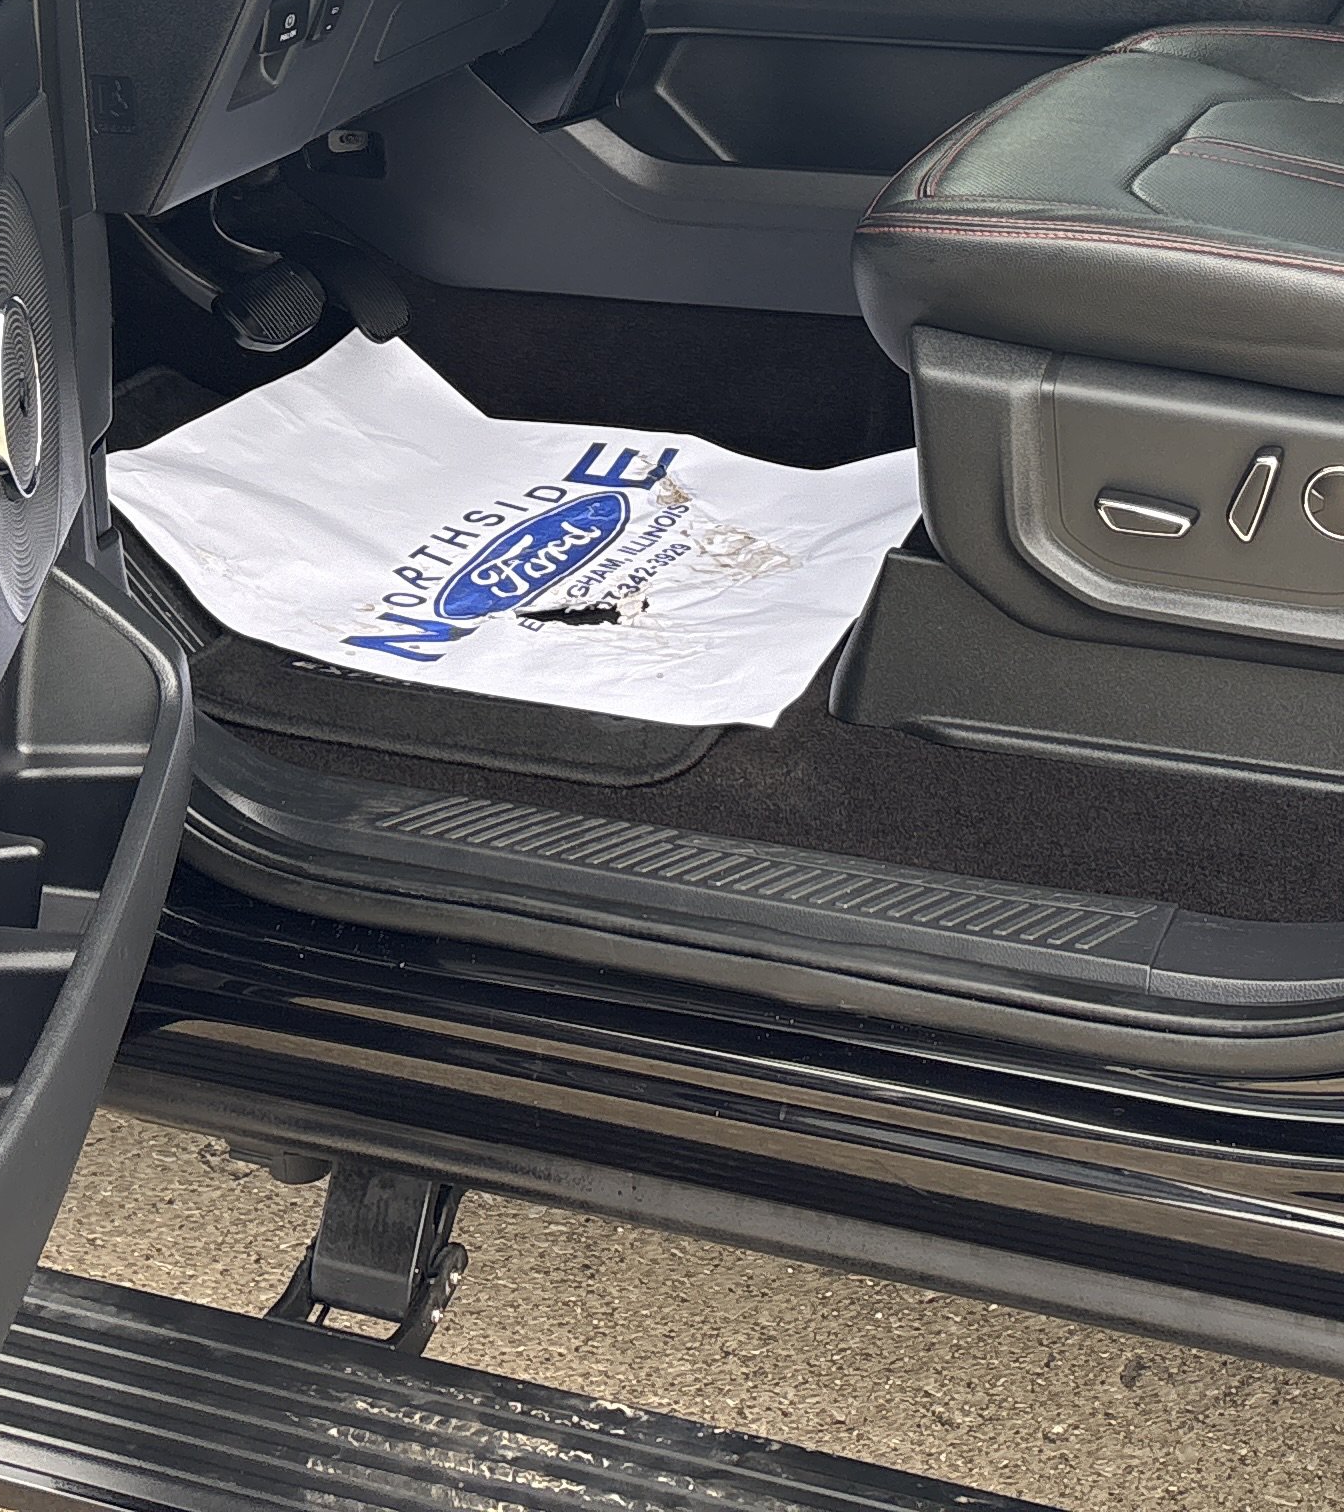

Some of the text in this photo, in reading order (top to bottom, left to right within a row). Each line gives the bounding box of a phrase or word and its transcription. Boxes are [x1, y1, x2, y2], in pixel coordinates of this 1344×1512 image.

[340, 442, 679, 662] NORTHSIDE
[470, 520, 601, 598] Ford
[617, 504, 691, 556] ILLINOIS
